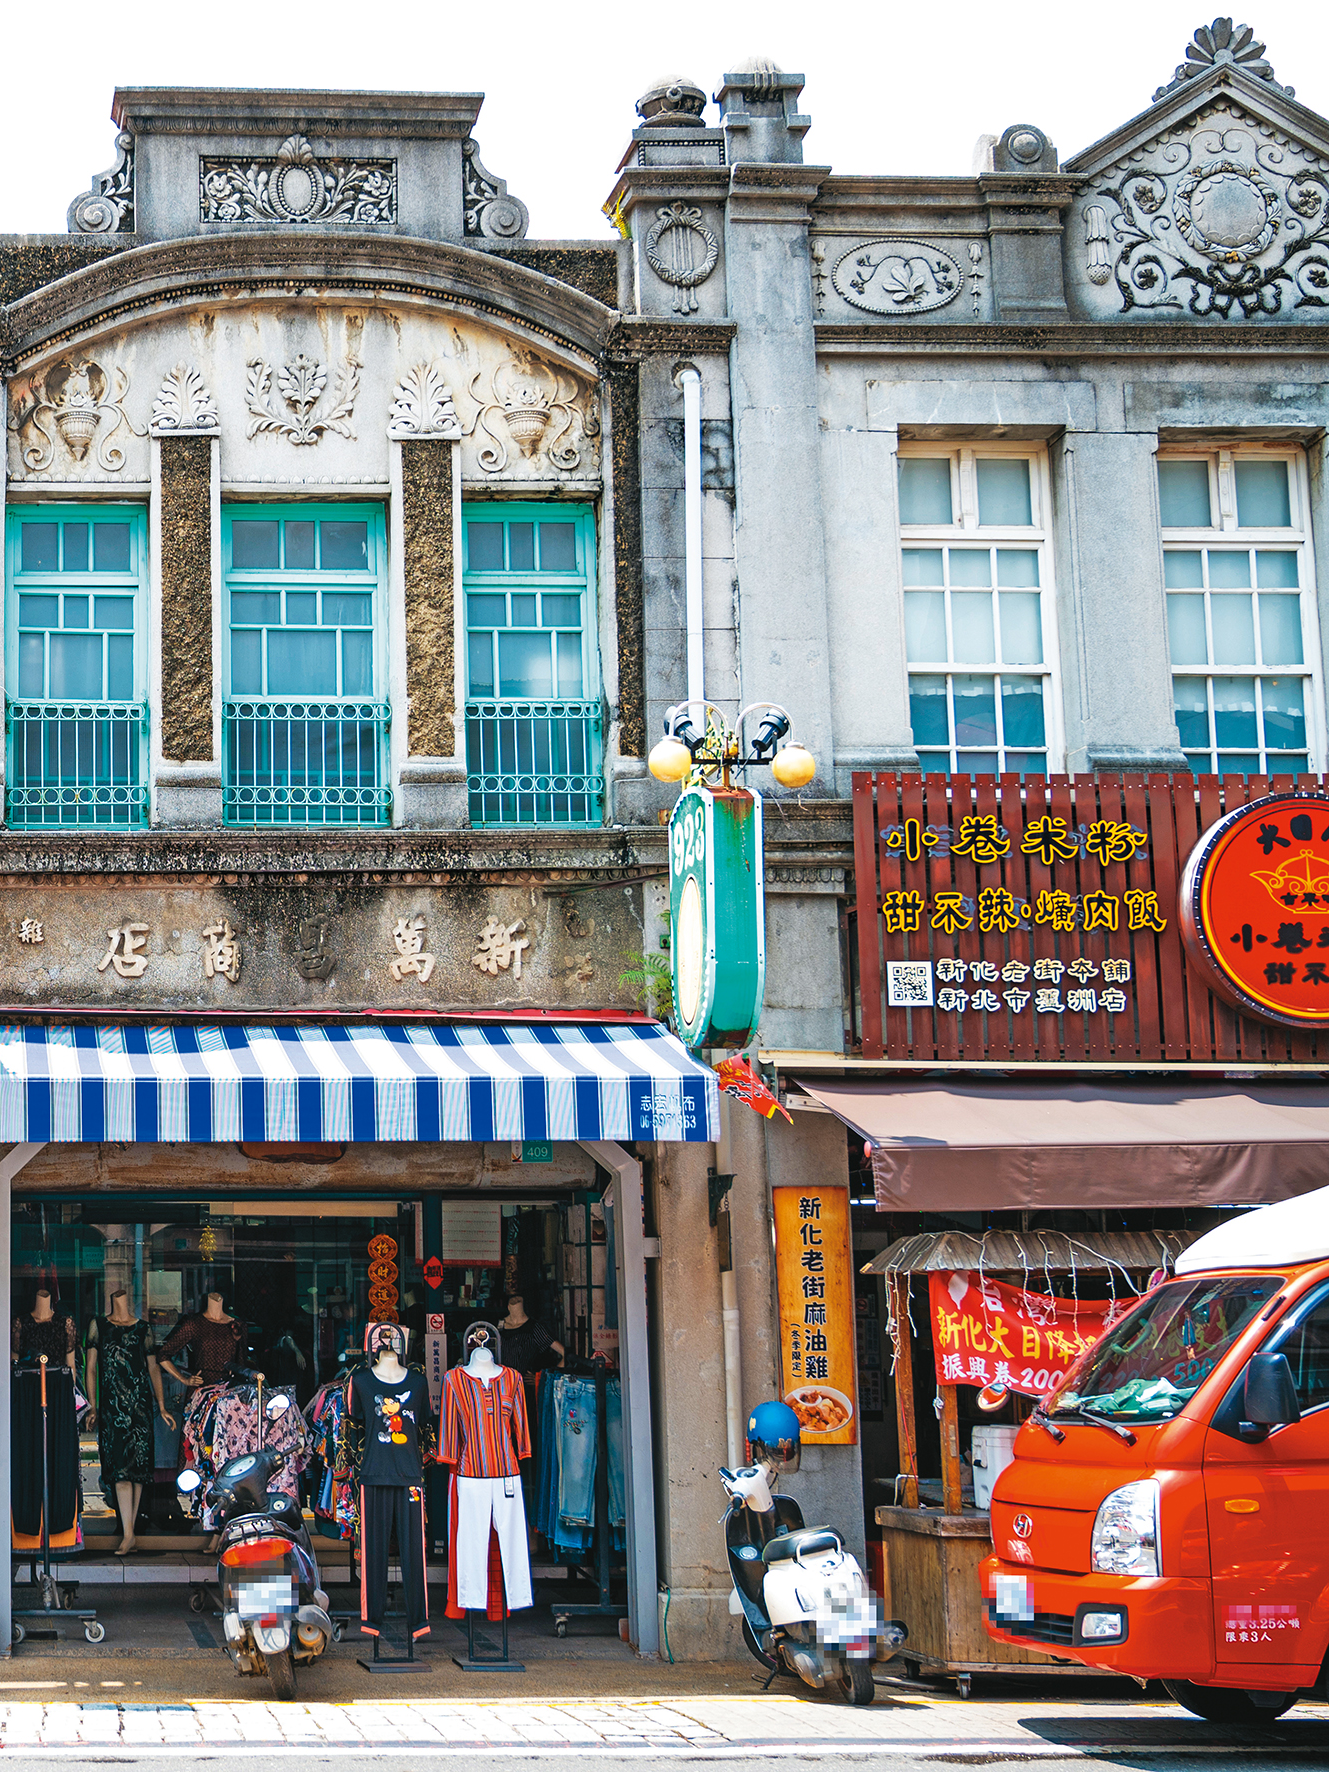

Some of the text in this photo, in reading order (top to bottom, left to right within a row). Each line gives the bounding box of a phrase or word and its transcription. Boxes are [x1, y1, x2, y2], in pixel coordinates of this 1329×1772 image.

[673, 805, 705, 877] 923
[887, 815, 1149, 866] 小卷米粉
[527, 1146, 548, 1158] 409
[798, 1196, 829, 1380] 新化老街麻油雞
